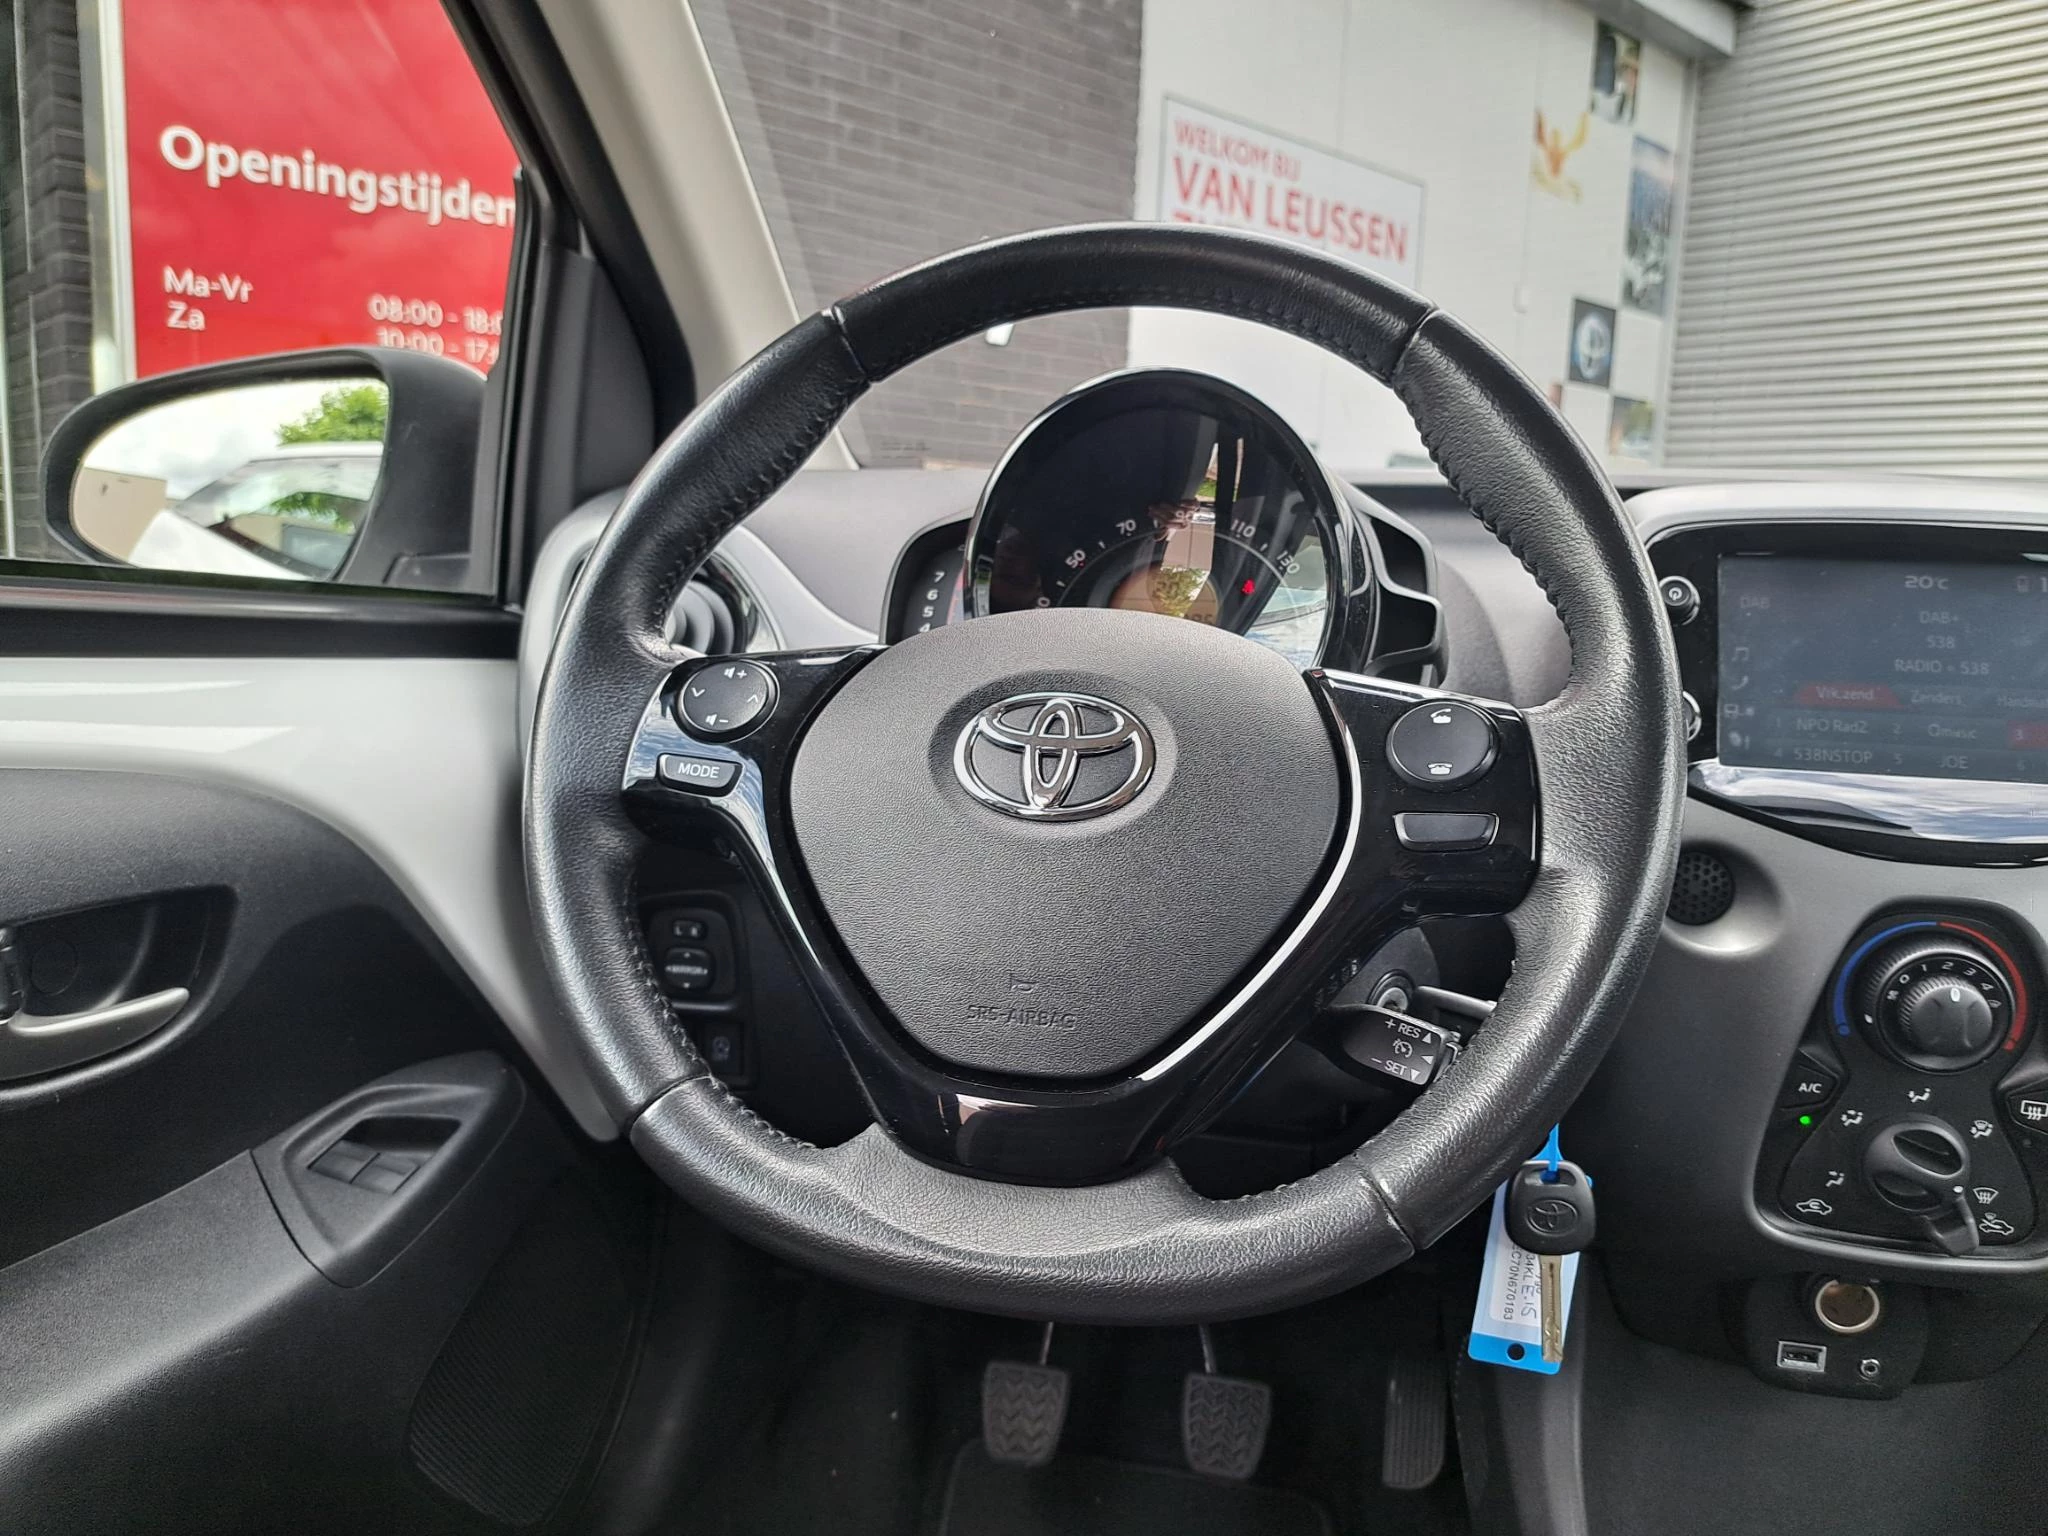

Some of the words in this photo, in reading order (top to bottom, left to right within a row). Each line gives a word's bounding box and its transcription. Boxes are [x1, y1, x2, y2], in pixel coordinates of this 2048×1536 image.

[1174, 120, 1270, 173] WELKOM
[1273, 153, 1301, 182] BIJ
[159, 124, 515, 227] Openingstijden
[1174, 155, 1255, 222] VAN
[1265, 183, 1408, 264] LEUSSEN
[164, 265, 254, 303] Ma-Vr
[167, 300, 206, 331] Za
[368, 294, 444, 328] 08:00
[1116, 519, 1137, 535] 70
[1230, 519, 1257, 538] 110
[1065, 549, 1087, 569] 50
[1276, 551, 1301, 575] 130
[933, 571, 945, 583] 7
[926, 589, 939, 601] 6
[922, 605, 934, 618] 5
[1926, 634, 1956, 649] 538
[1894, 658, 1942, 673] RADIO
[1959, 661, 1990, 675] 538
[1797, 717, 1829, 732] NPO
[1832, 719, 1868, 734] Rad2
[1794, 748, 1873, 764] 538NSTOP
[1938, 755, 1968, 769] JOE
[677, 762, 720, 779] MODE
[1920, 963, 1928, 972] 1
[1941, 961, 1954, 970] 2
[1963, 967, 1977, 976] 3
[1980, 982, 1994, 991] 4
[1397, 1023, 1422, 1039] RES
[1384, 1059, 1408, 1077] SET
[1798, 1082, 1823, 1094] A/C
